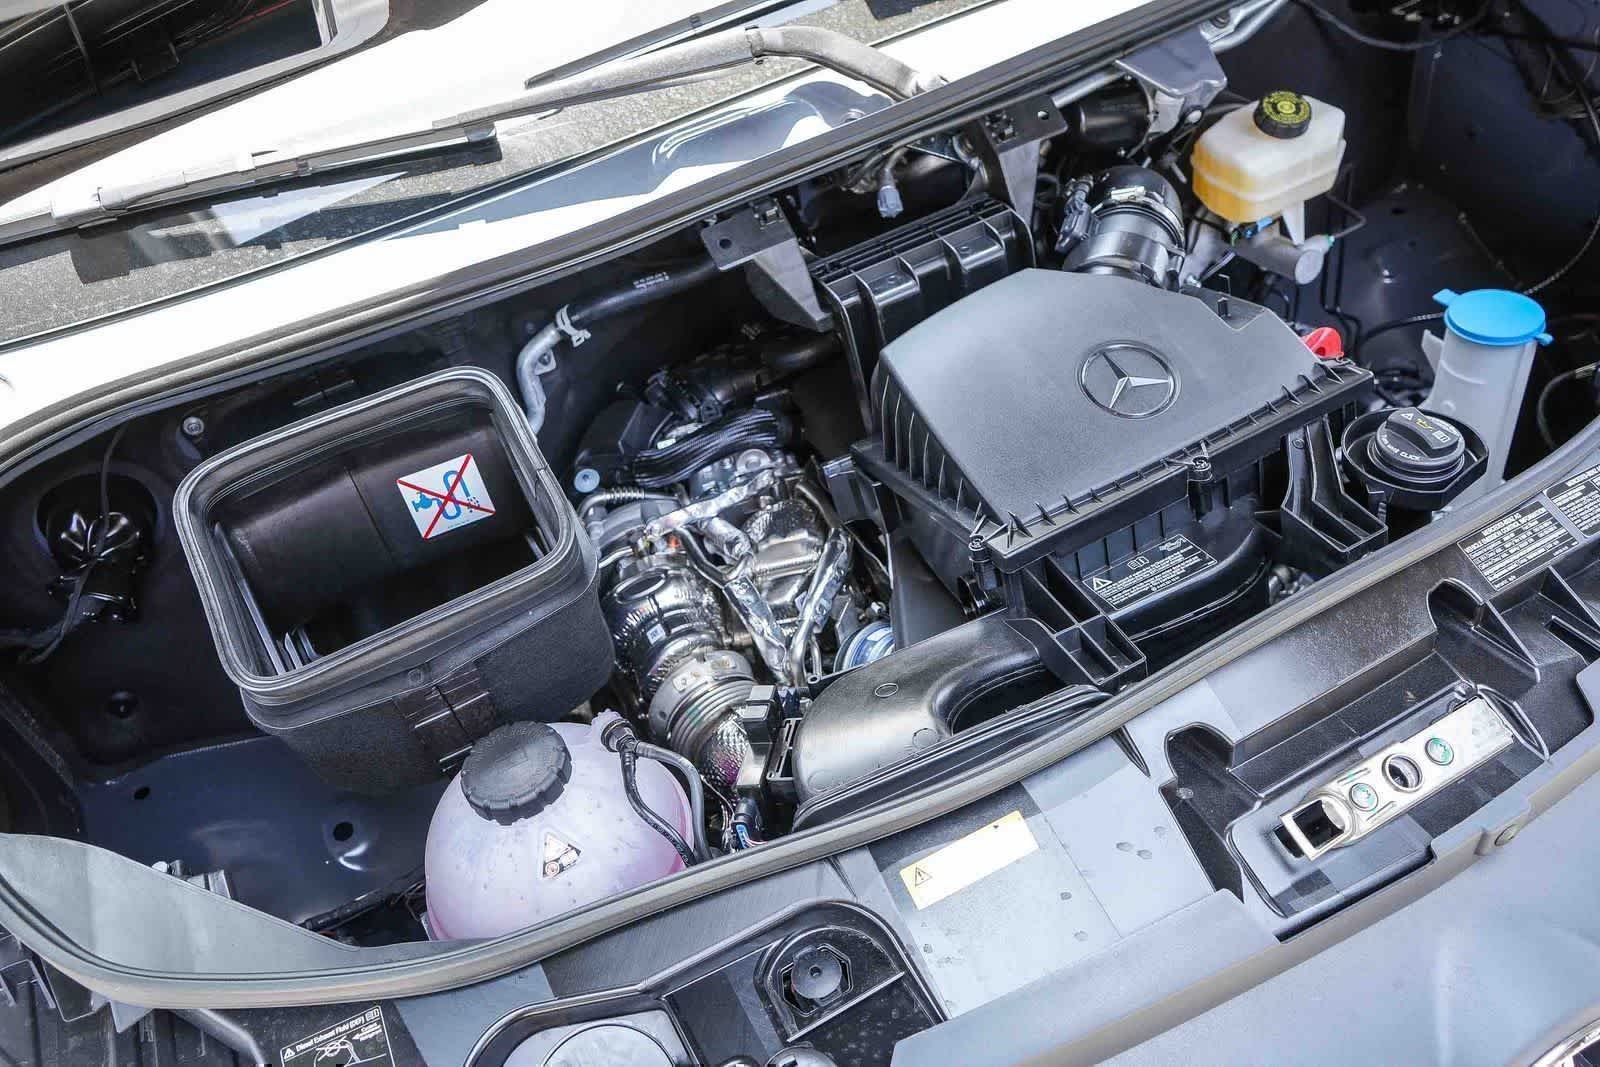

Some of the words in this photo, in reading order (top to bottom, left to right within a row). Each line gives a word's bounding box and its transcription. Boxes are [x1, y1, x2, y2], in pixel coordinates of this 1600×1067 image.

[296, 1039, 314, 1052] Diesel
[315, 1030, 335, 1043] Exhaust
[336, 1023, 349, 1034] Fluid
